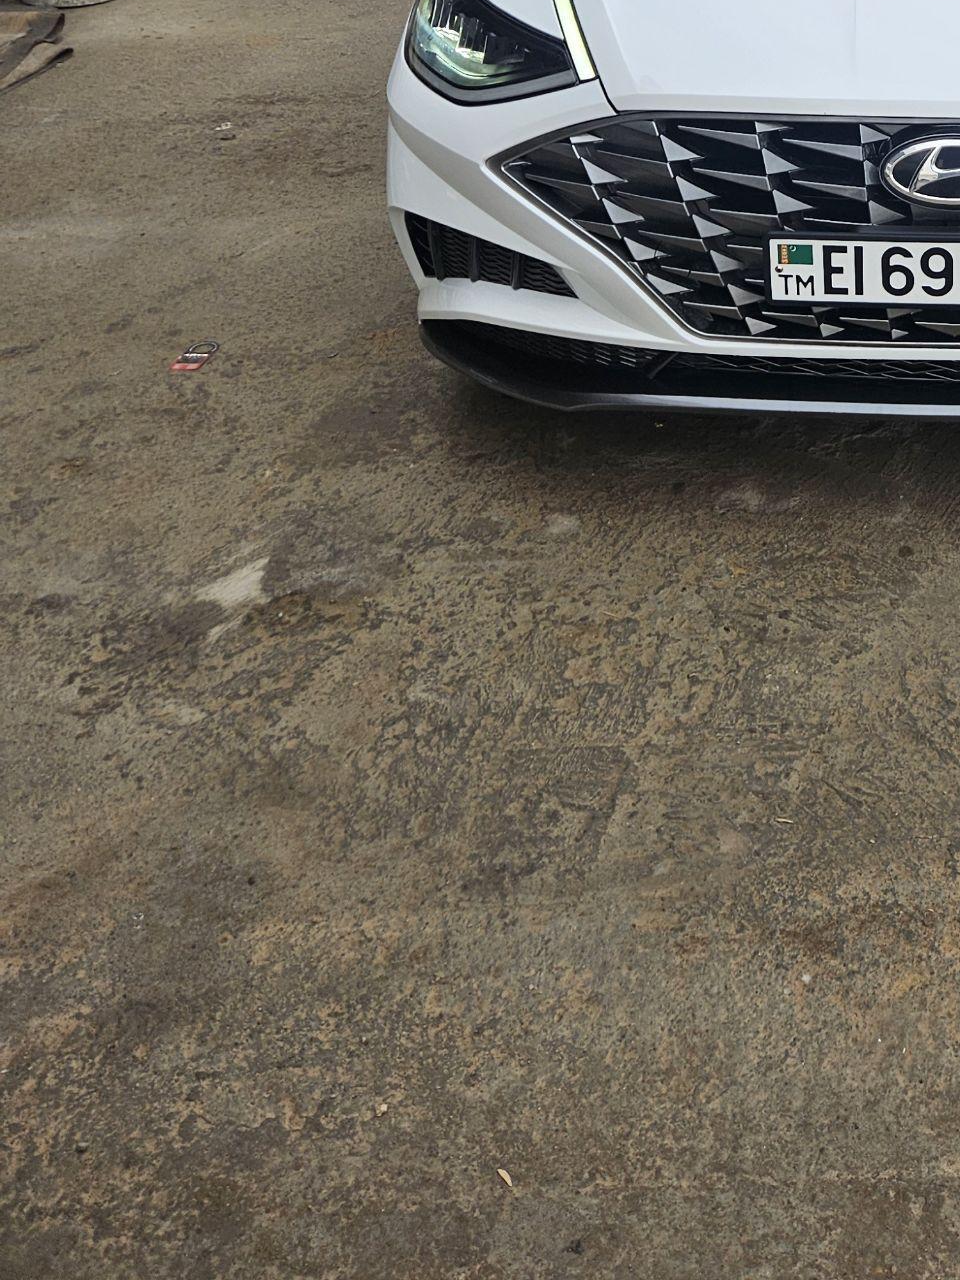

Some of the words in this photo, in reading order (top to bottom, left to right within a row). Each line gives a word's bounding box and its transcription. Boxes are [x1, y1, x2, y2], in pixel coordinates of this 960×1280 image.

[778, 273, 815, 297] TM
[822, 244, 864, 296] EI
[881, 246, 954, 297] 69
